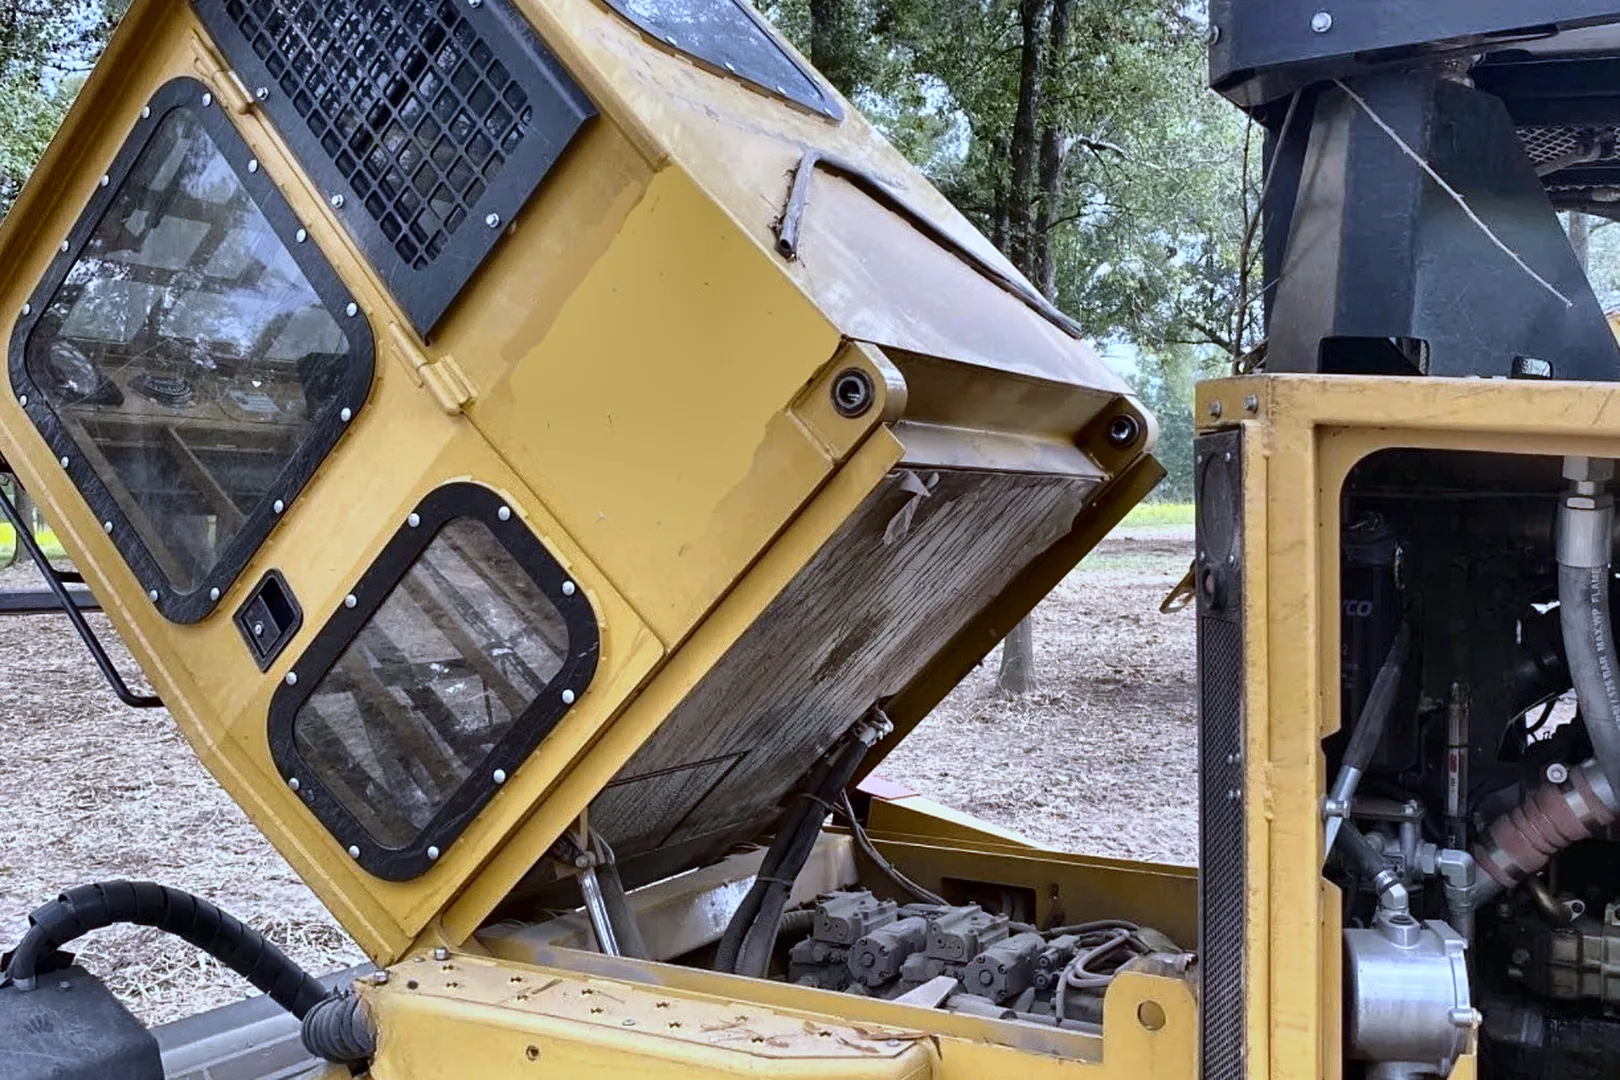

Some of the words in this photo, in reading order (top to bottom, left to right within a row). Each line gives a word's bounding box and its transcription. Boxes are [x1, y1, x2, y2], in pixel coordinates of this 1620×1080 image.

[1343, 600, 1372, 617] CO
[1595, 628, 1604, 652] MAX
[1599, 655, 1611, 679] BAR
